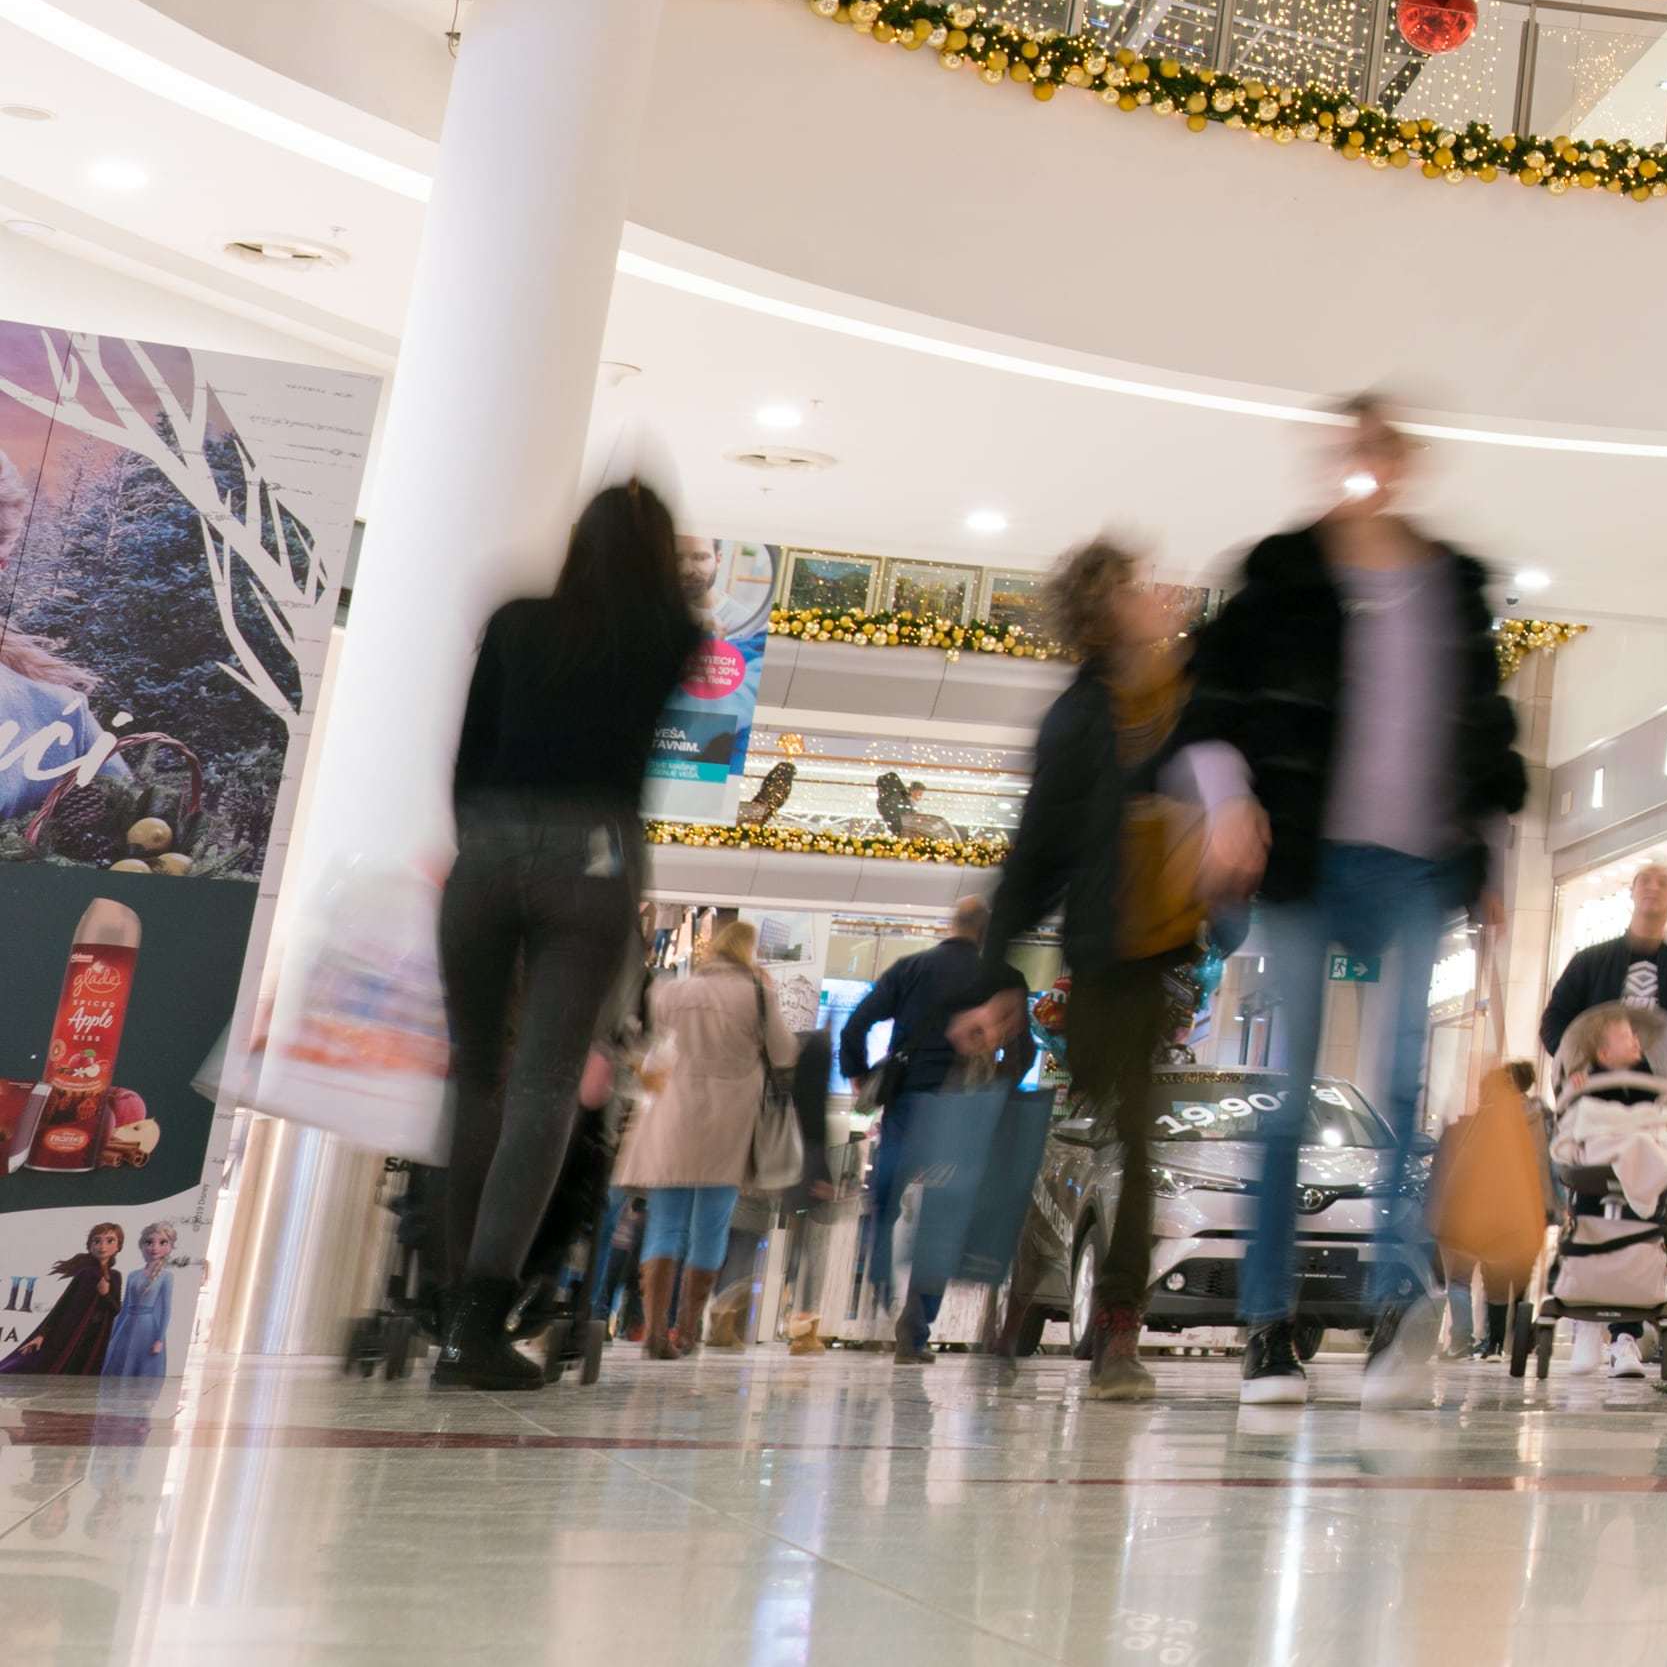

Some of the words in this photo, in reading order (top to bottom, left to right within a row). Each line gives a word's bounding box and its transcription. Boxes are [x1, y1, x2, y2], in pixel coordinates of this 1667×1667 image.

[651, 739, 700, 752] TAVNIM.
[73, 962, 120, 996] glade
[73, 999, 116, 1008] SPICED
[68, 1006, 113, 1033] Apple
